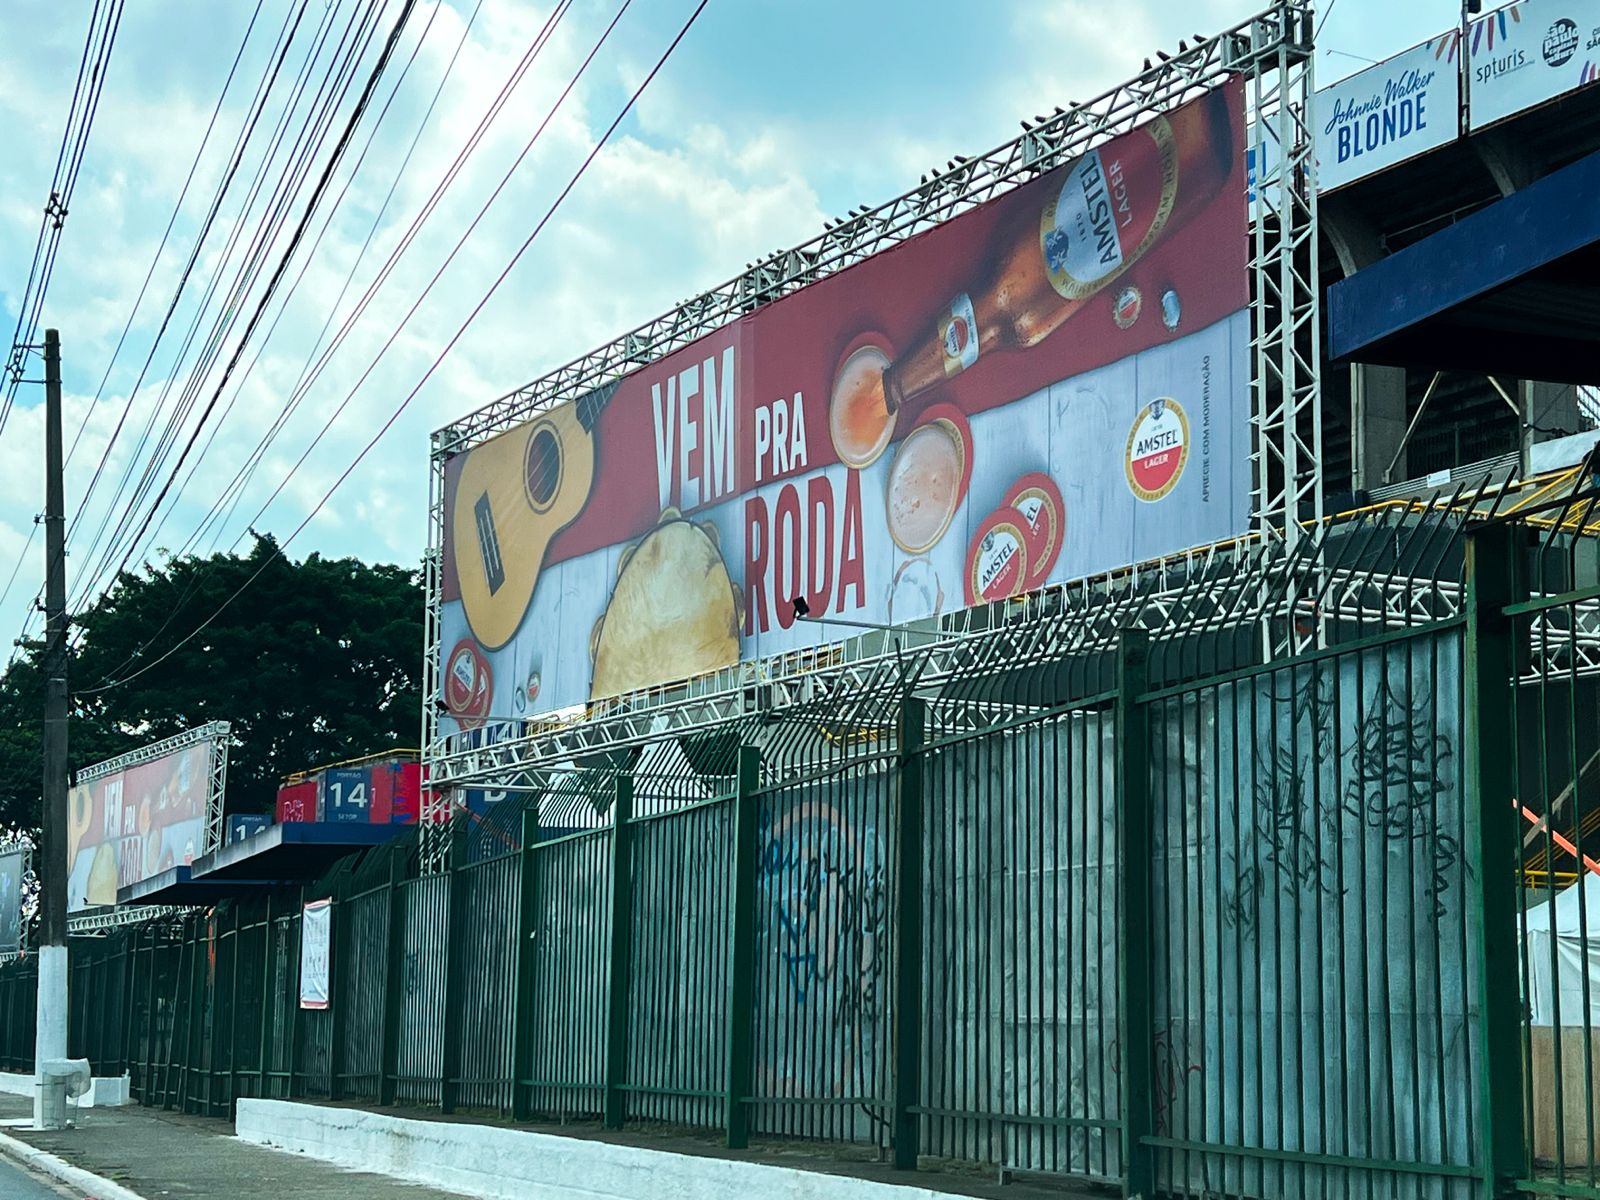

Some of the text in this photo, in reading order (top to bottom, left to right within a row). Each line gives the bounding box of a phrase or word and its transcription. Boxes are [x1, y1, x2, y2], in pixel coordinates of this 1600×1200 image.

[1477, 49, 1525, 83] spturis
[1325, 68, 1435, 135] Johnnie Walker
[1337, 91, 1427, 164] BLONDE
[1080, 155, 1118, 265] AMSTEL
[1109, 159, 1132, 228] LAGER
[651, 345, 735, 512] VEM
[755, 391, 808, 482] PRA
[1136, 429, 1178, 456] AMSTEL
[1202, 430, 1210, 455] COM
[744, 466, 866, 638] RODA
[981, 543, 1014, 588] AMSTEL
[330, 782, 368, 808] 14
